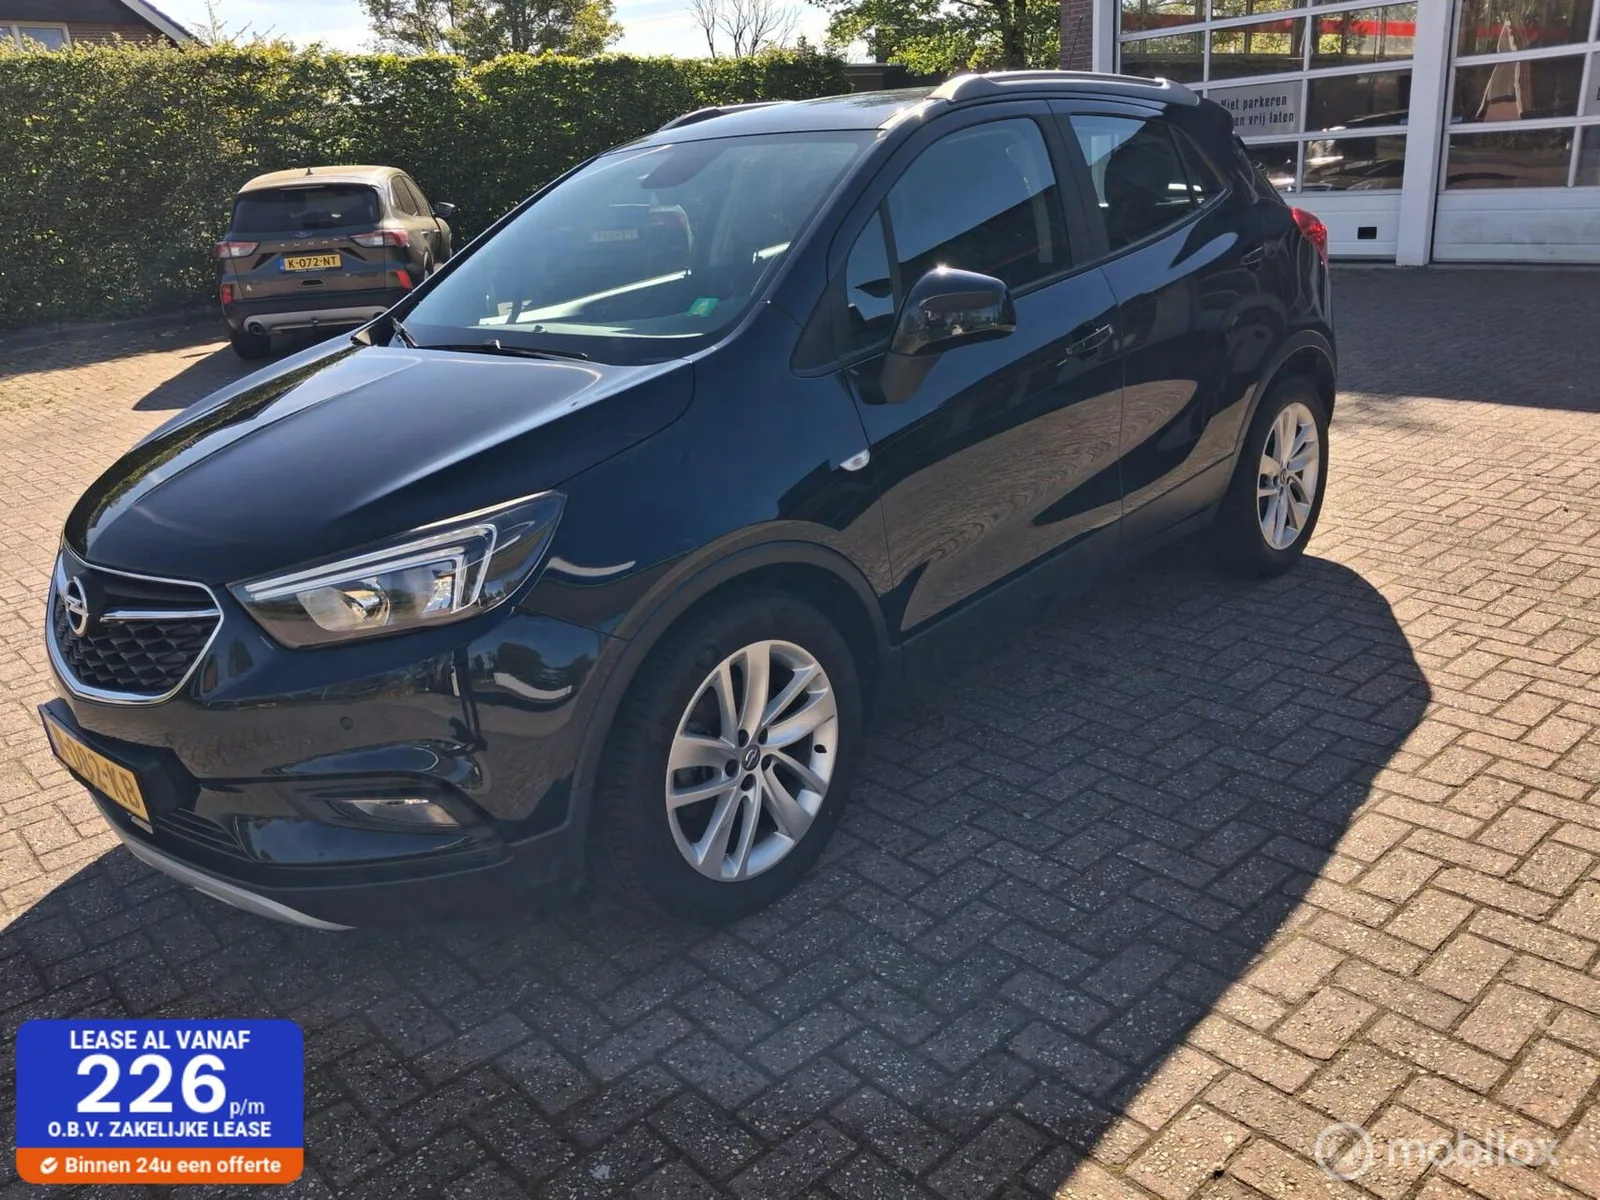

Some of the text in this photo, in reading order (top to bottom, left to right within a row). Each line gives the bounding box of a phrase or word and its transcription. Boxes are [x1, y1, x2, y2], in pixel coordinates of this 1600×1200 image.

[1243, 95, 1287, 111] parkeren
[1249, 112, 1266, 127] vrij
[1269, 110, 1294, 124] laten
[288, 256, 336, 269] K-072-NT
